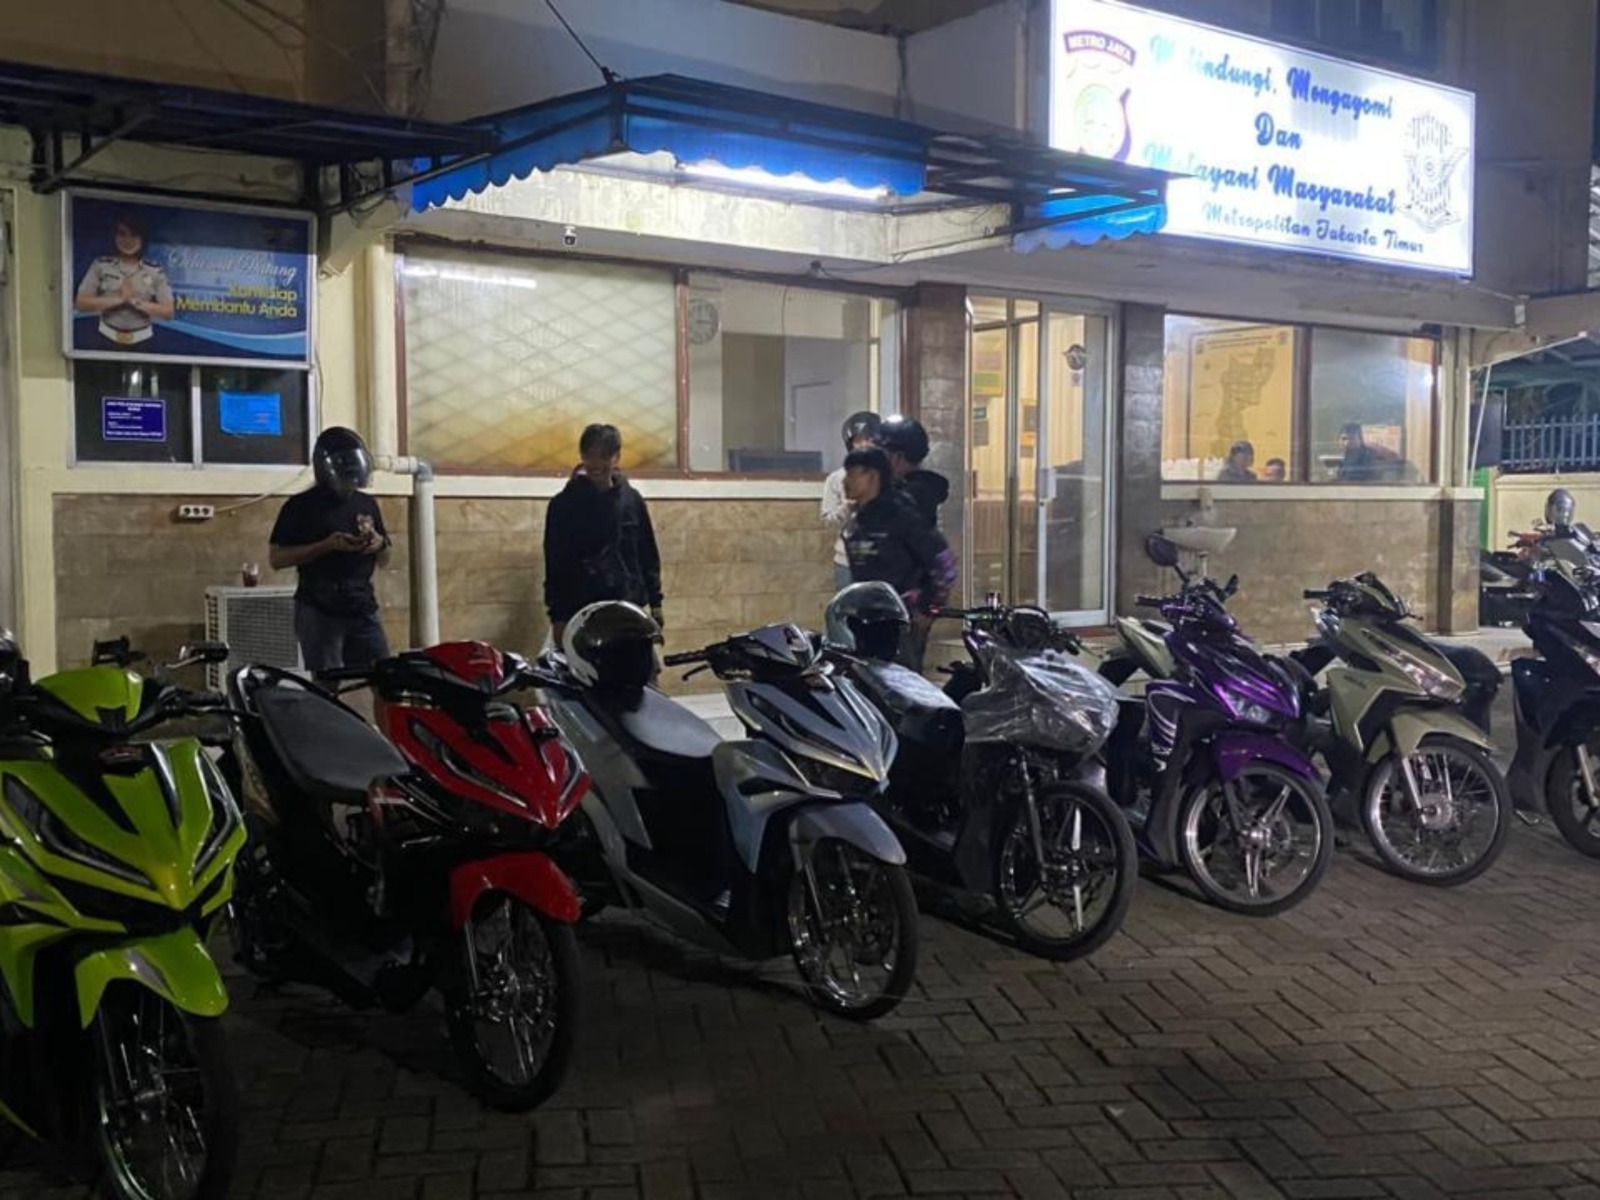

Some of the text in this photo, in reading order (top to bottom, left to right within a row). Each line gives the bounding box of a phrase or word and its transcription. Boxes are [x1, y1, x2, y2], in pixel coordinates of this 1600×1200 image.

[1287, 67, 1393, 120] Mengayomi
[1255, 112, 1301, 149] Dan
[1143, 142, 1396, 214] Mlayani Masyarakat
[1202, 201, 1424, 252] Metropolitan Jakarta Timur
[177, 295, 297, 317] Membantu Anda
